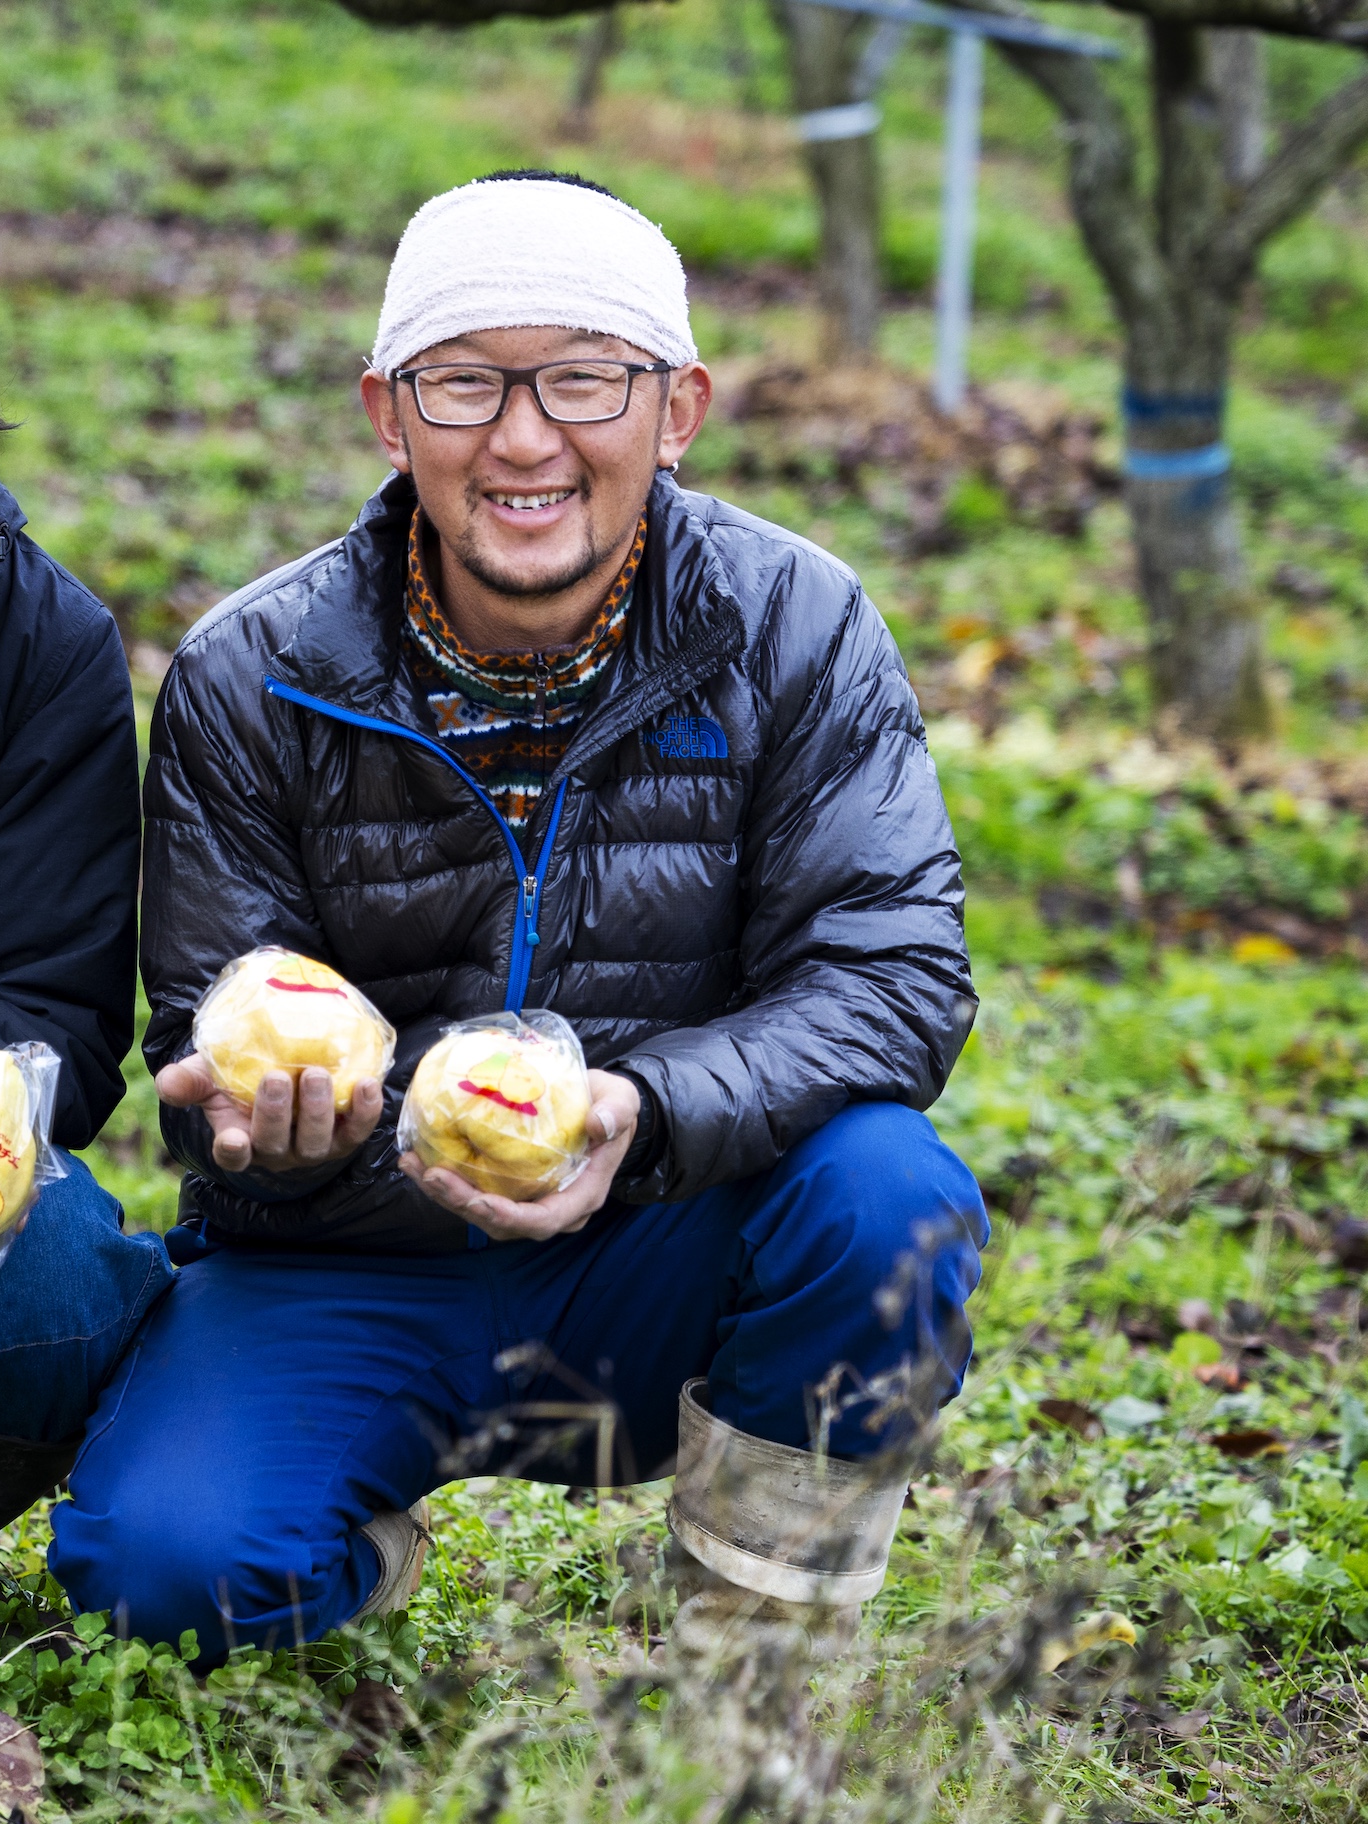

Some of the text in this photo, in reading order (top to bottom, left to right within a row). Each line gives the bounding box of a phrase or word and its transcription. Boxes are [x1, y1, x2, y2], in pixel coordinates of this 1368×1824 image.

[667, 715, 699, 731] THE
[643, 730, 700, 745] NORTH
[659, 744, 701, 759] FACE
